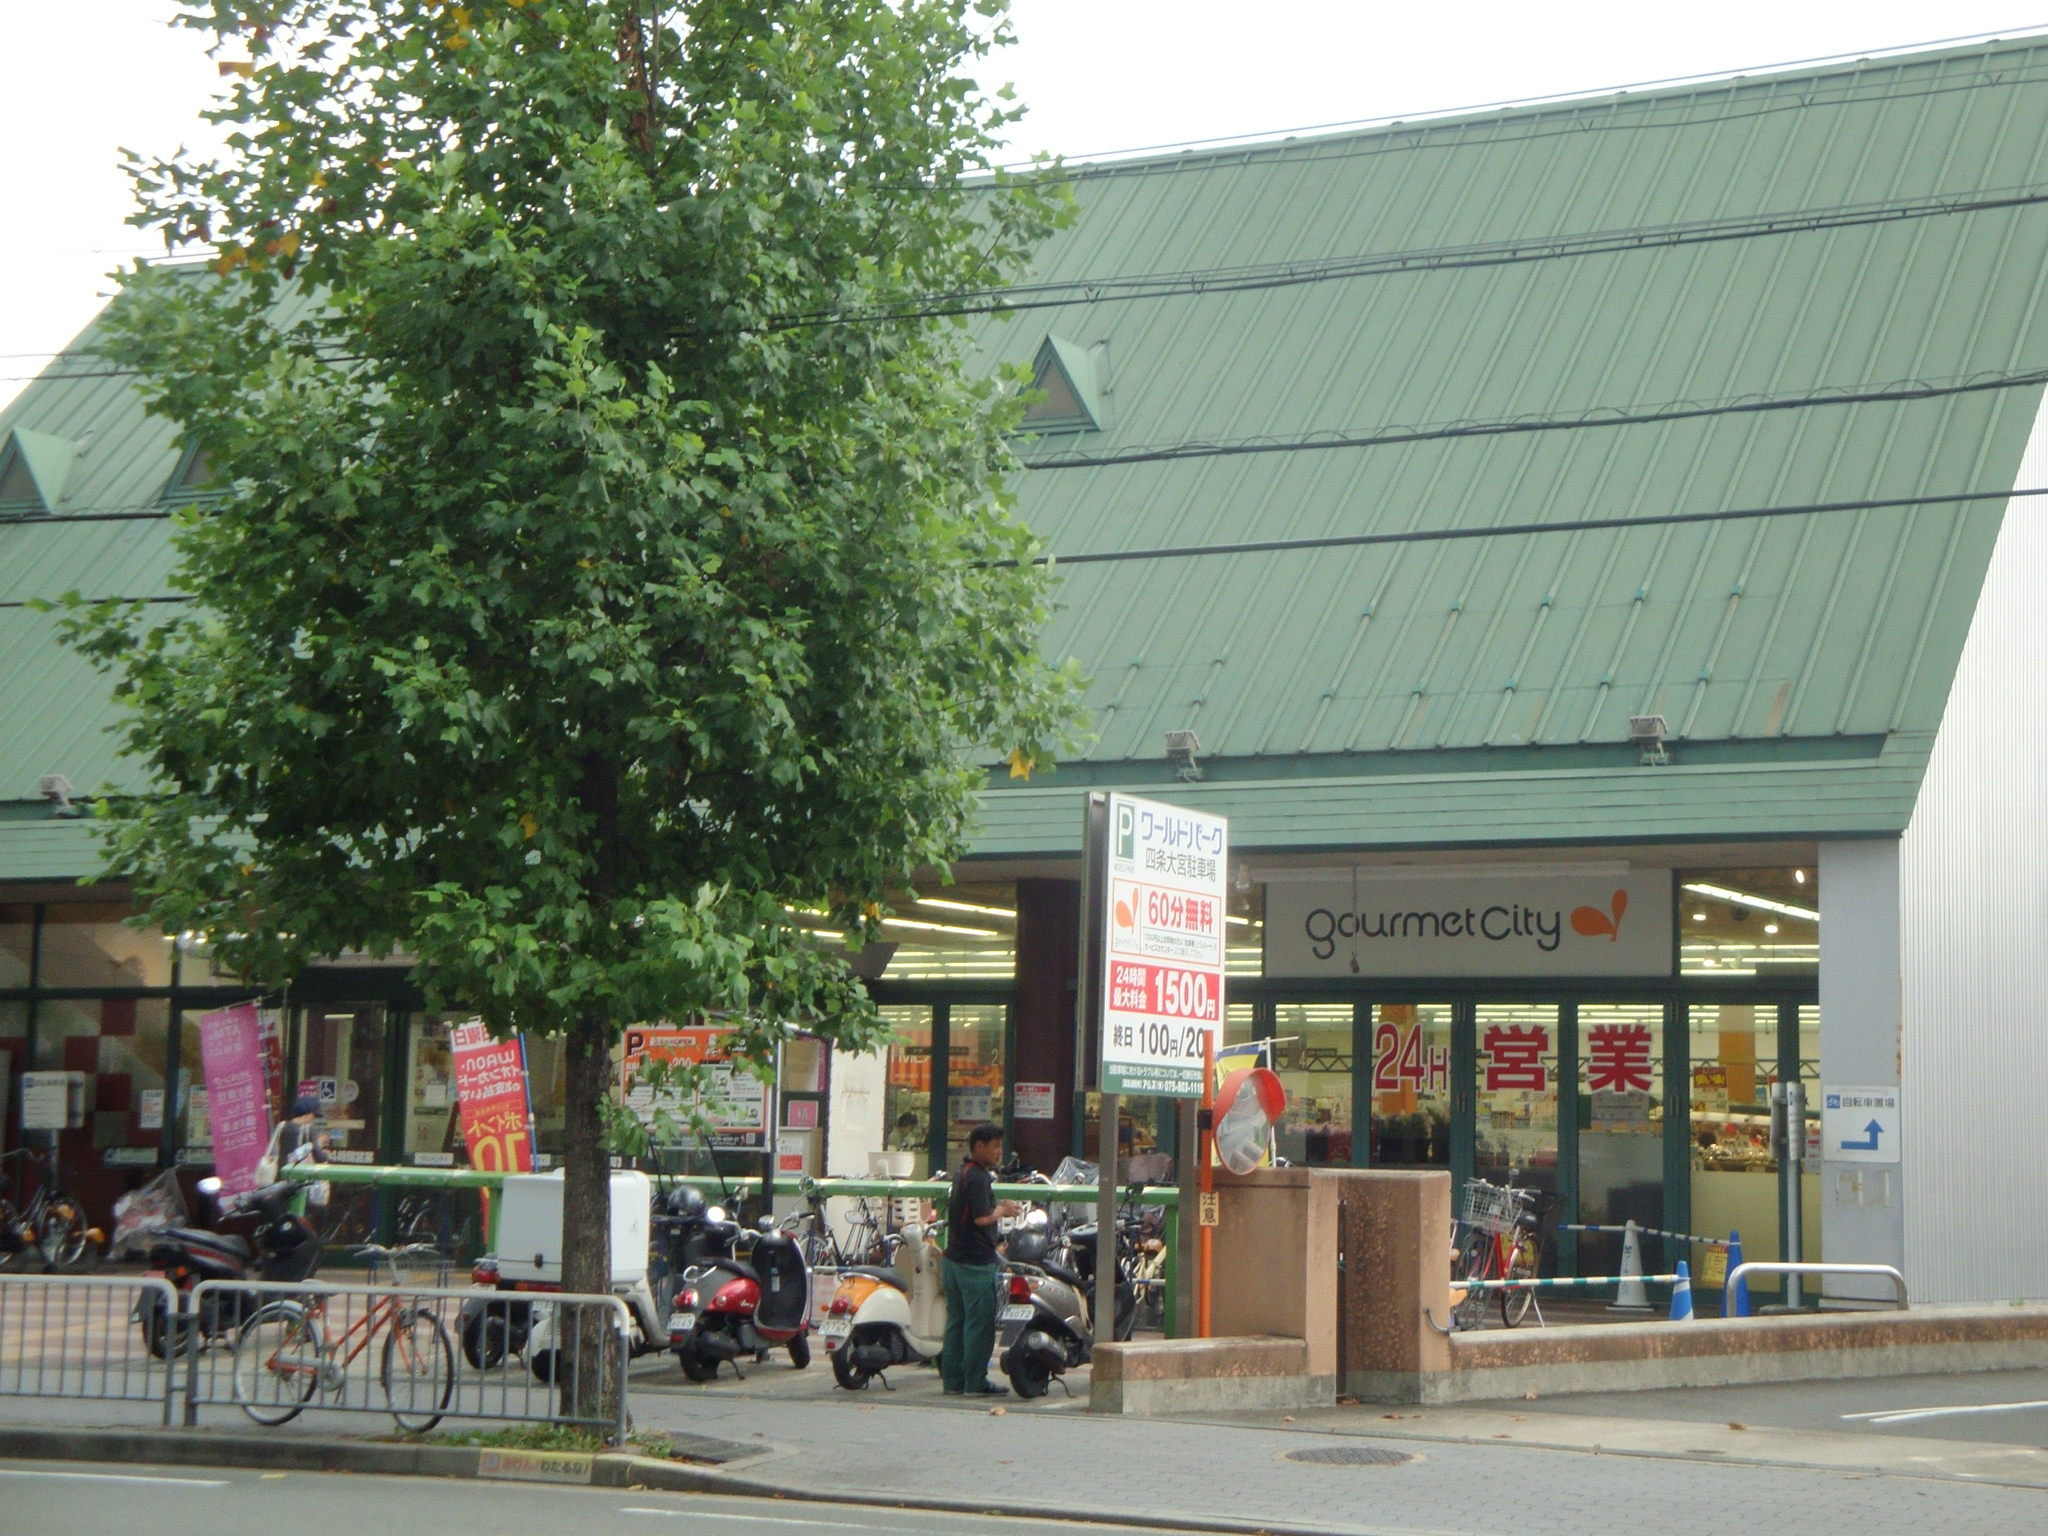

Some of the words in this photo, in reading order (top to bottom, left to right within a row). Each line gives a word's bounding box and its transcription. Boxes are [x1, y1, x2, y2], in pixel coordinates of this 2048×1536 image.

[1117, 804, 1134, 856] P
[1141, 811, 1223, 856] ワールドパーク
[1145, 847, 1217, 883] 四条大宮駐車場
[1148, 890, 1213, 934] 60分無料
[1113, 987, 1147, 1010] 最大料金
[1116, 966, 1147, 988] 24時間
[1155, 968, 1216, 1019] 1500円
[1113, 1024, 1133, 1047] 終日
[1842, 1097, 1895, 1108] 自転車置場
[1202, 1192, 1217, 1224] 注意
